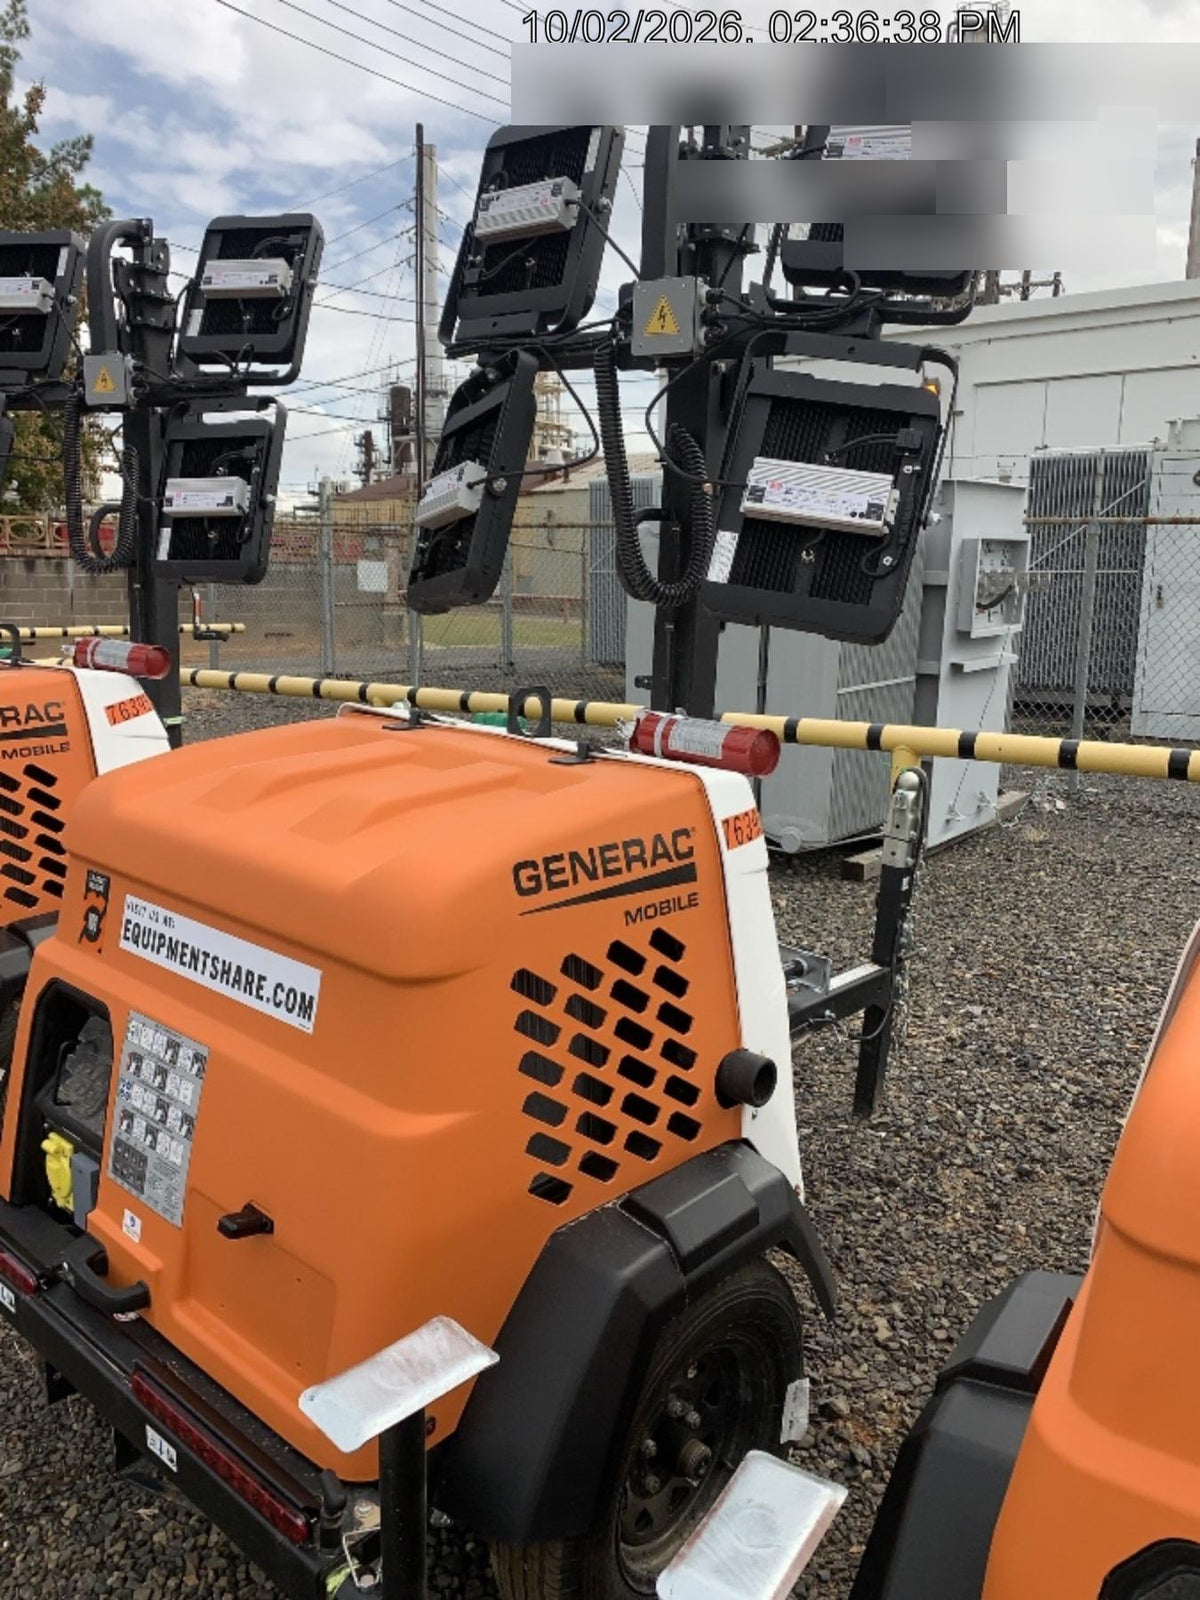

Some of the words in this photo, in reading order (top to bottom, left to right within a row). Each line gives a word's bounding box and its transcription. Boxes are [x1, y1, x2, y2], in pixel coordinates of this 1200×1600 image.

[1, 741, 71, 760] MOBILE
[513, 828, 696, 897] GENERAC
[624, 892, 700, 926] MOBILE
[122, 918, 315, 1023] EQUIPMENTSHARE.COM
